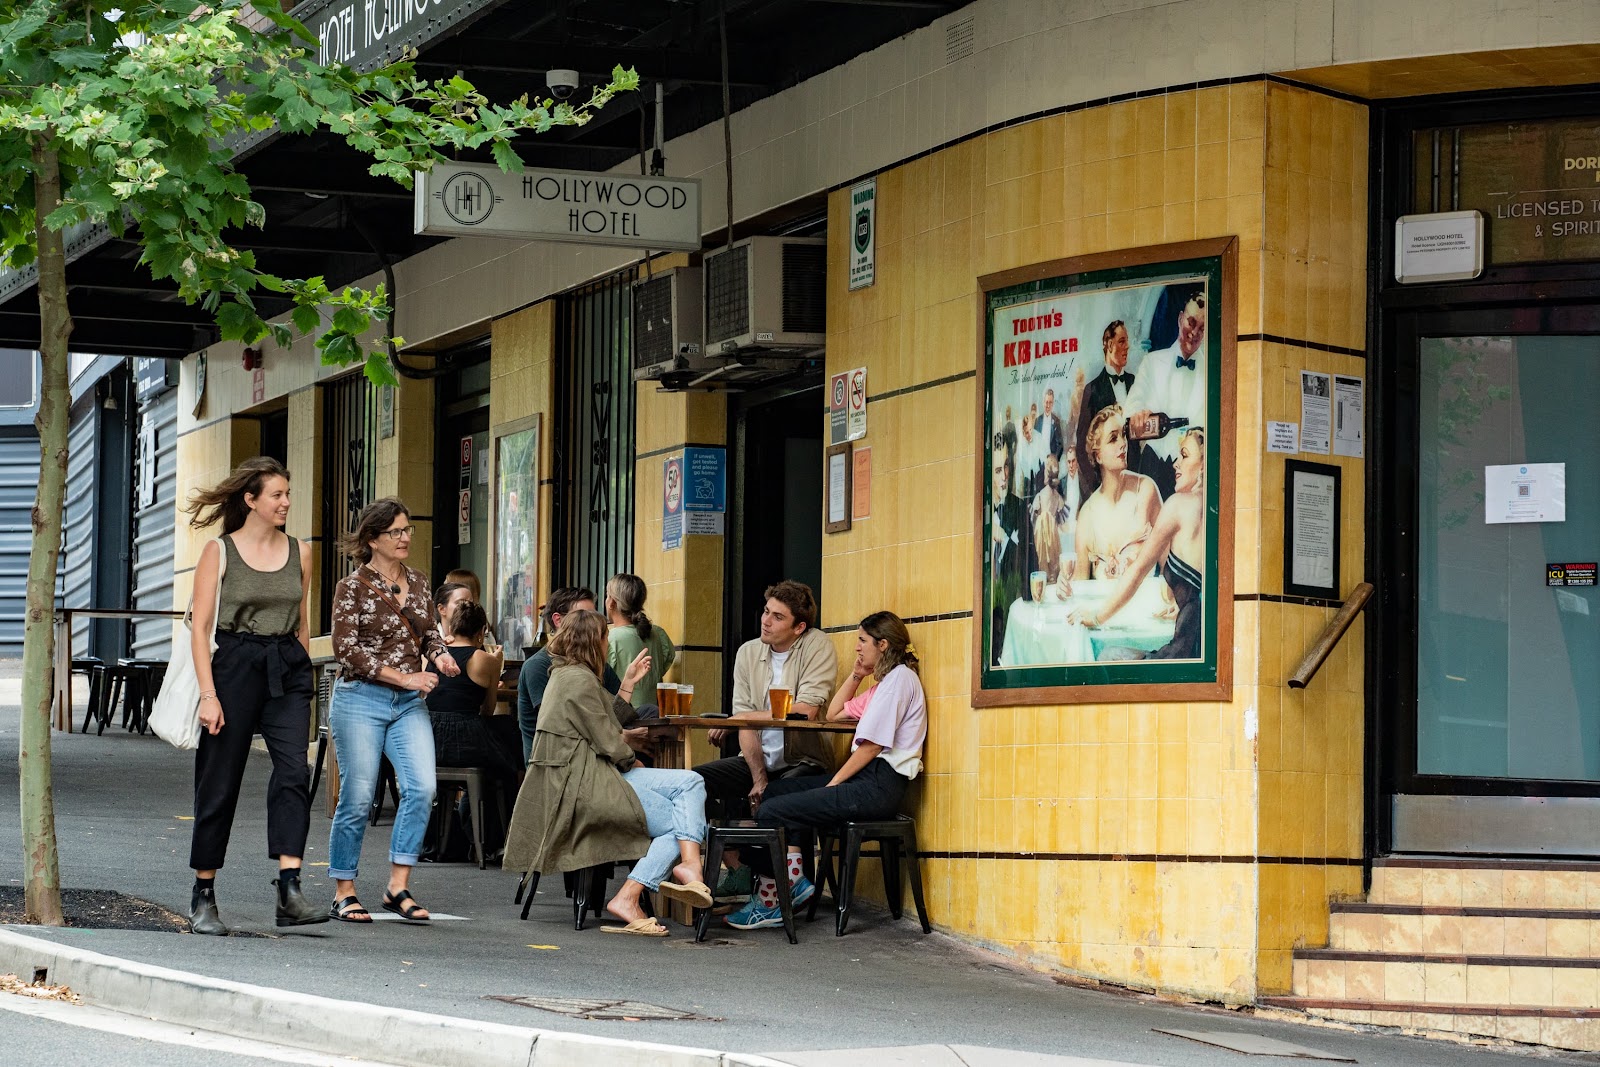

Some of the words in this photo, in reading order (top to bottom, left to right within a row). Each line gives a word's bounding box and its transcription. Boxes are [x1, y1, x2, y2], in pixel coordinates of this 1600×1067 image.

[319, 4, 355, 67] HOTEL
[1564, 156, 1600, 171] DOR
[522, 176, 687, 210] HOLLYWOOD
[1497, 200, 1584, 219] LICENSED
[1591, 199, 1600, 214] T
[568, 209, 640, 236] HOTEL
[1535, 224, 1543, 238] &
[1413, 234, 1446, 242] HOLLYWOOD
[1012, 308, 1063, 336] TOOTH'S
[1003, 339, 1031, 368] KB
[1034, 337, 1078, 359] LAGER
[1548, 570, 1564, 579] ICU
